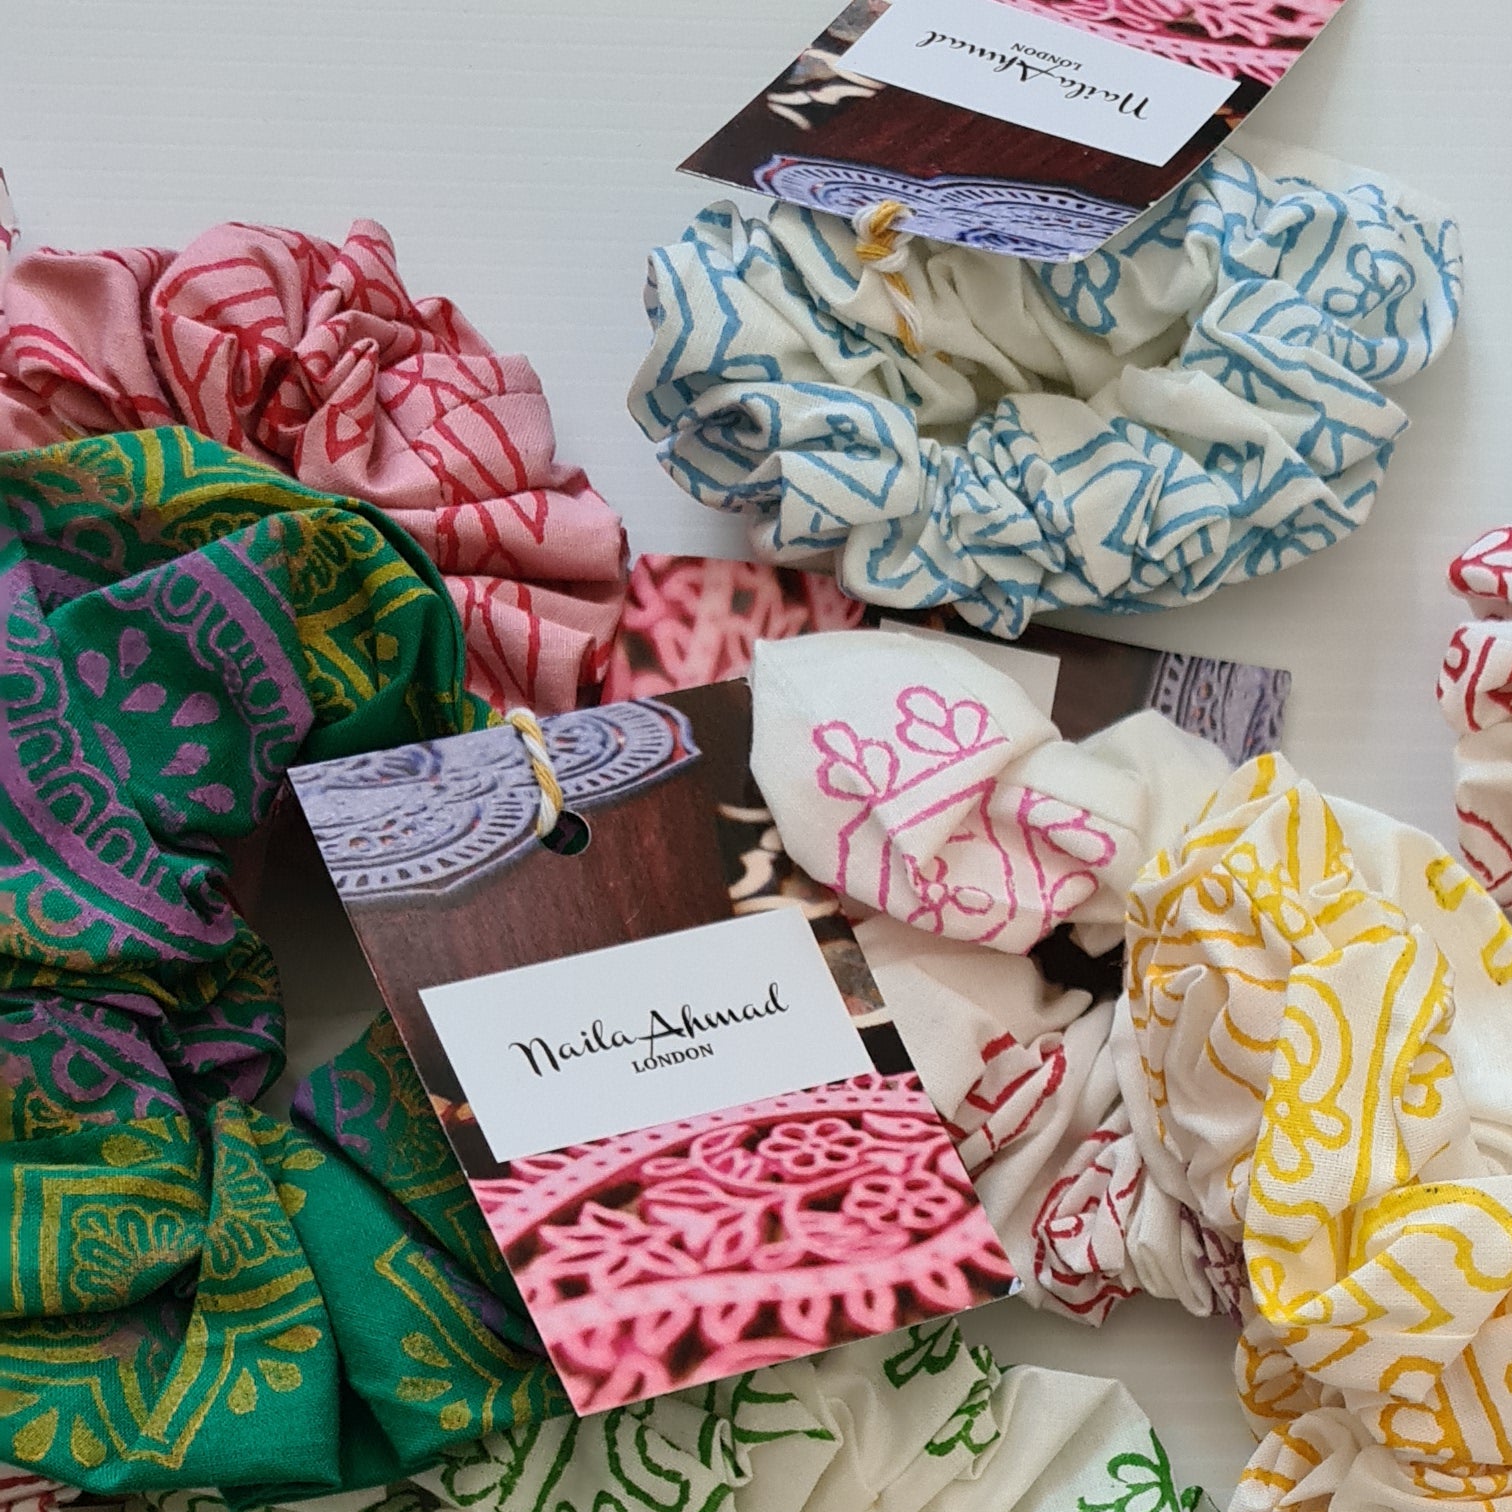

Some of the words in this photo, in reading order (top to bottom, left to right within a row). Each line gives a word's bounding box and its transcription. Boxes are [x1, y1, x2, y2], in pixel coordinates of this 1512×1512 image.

[915, 30, 1064, 83] Ahmad
[1010, 42, 1082, 72] LONDON
[1048, 73, 1148, 121] Naila
[508, 1019, 638, 1078] Naila
[635, 981, 790, 1058] Ahmad
[631, 1043, 715, 1074] LONDON
